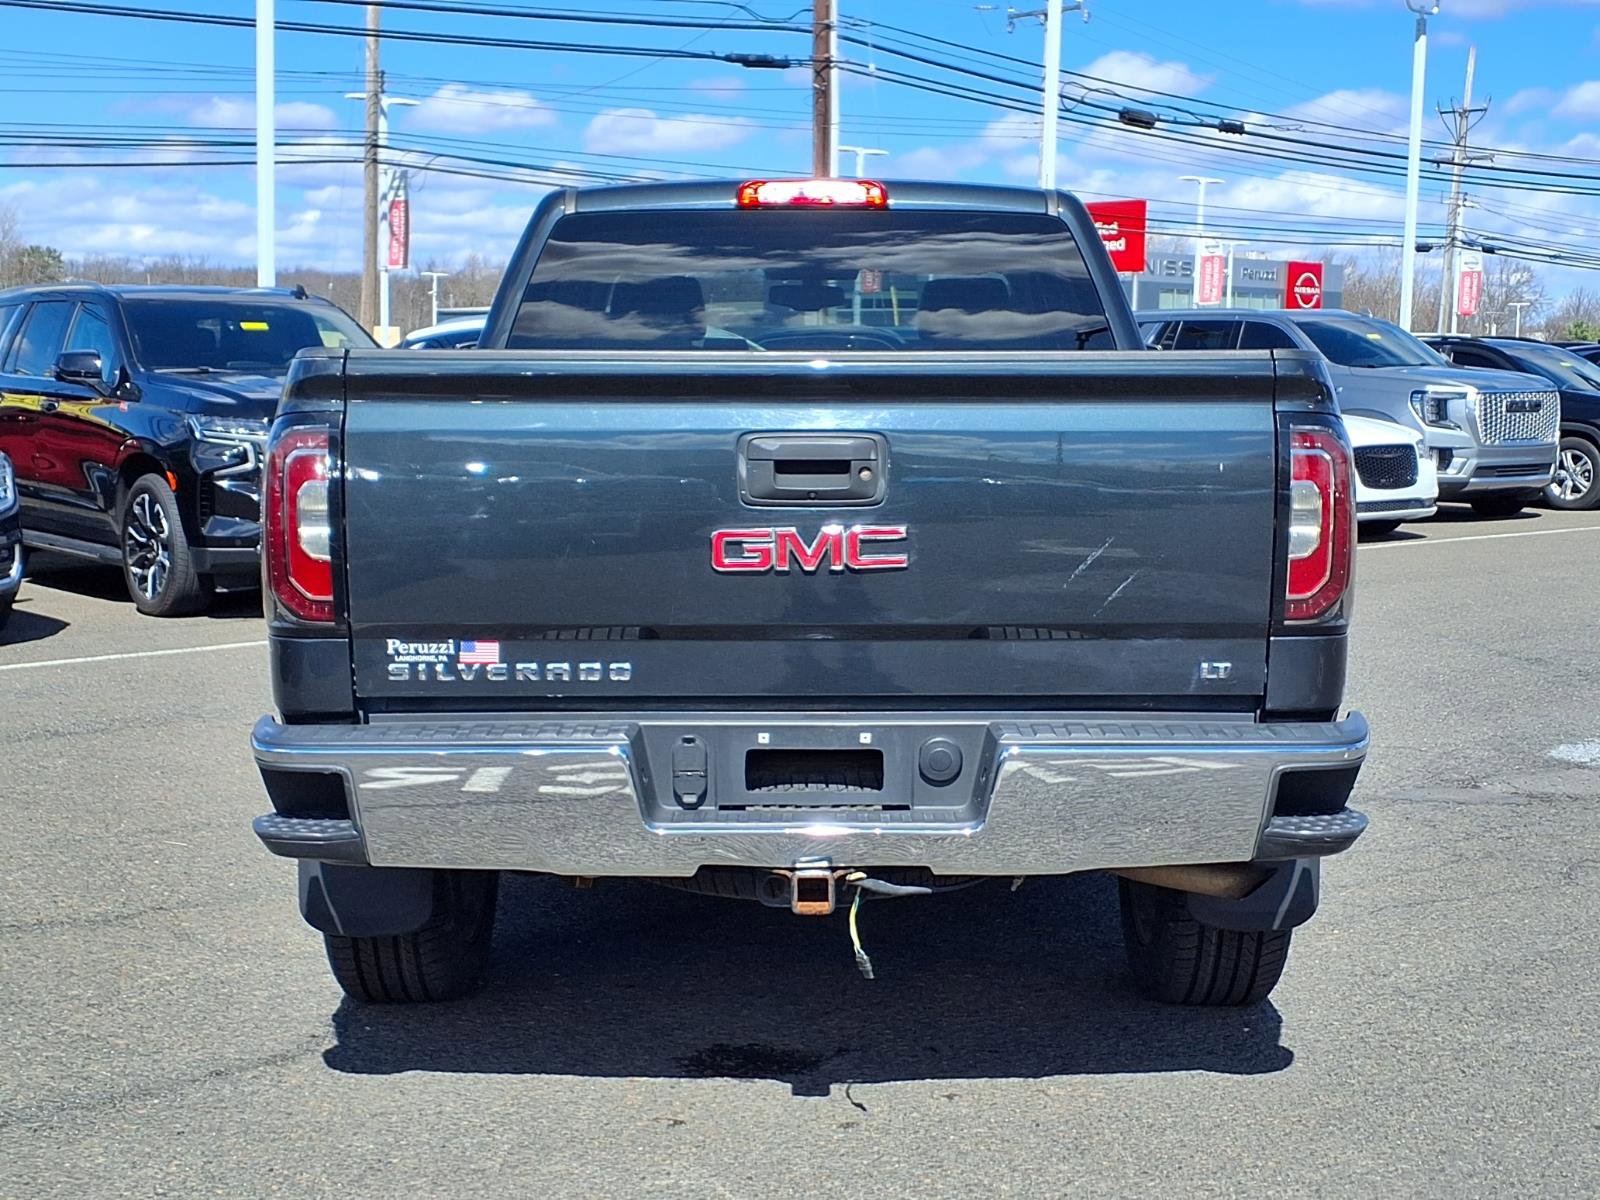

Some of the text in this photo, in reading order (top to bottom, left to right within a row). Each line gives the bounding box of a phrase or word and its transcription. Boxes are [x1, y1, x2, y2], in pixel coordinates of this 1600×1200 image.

[1241, 267, 1277, 281] Peruzzi
[1294, 286, 1320, 295] NISSAN
[711, 524, 908, 571] GMC
[386, 638, 455, 655] Peruzzi
[386, 662, 632, 681] SILVERADO
[1200, 662, 1232, 679] LT
